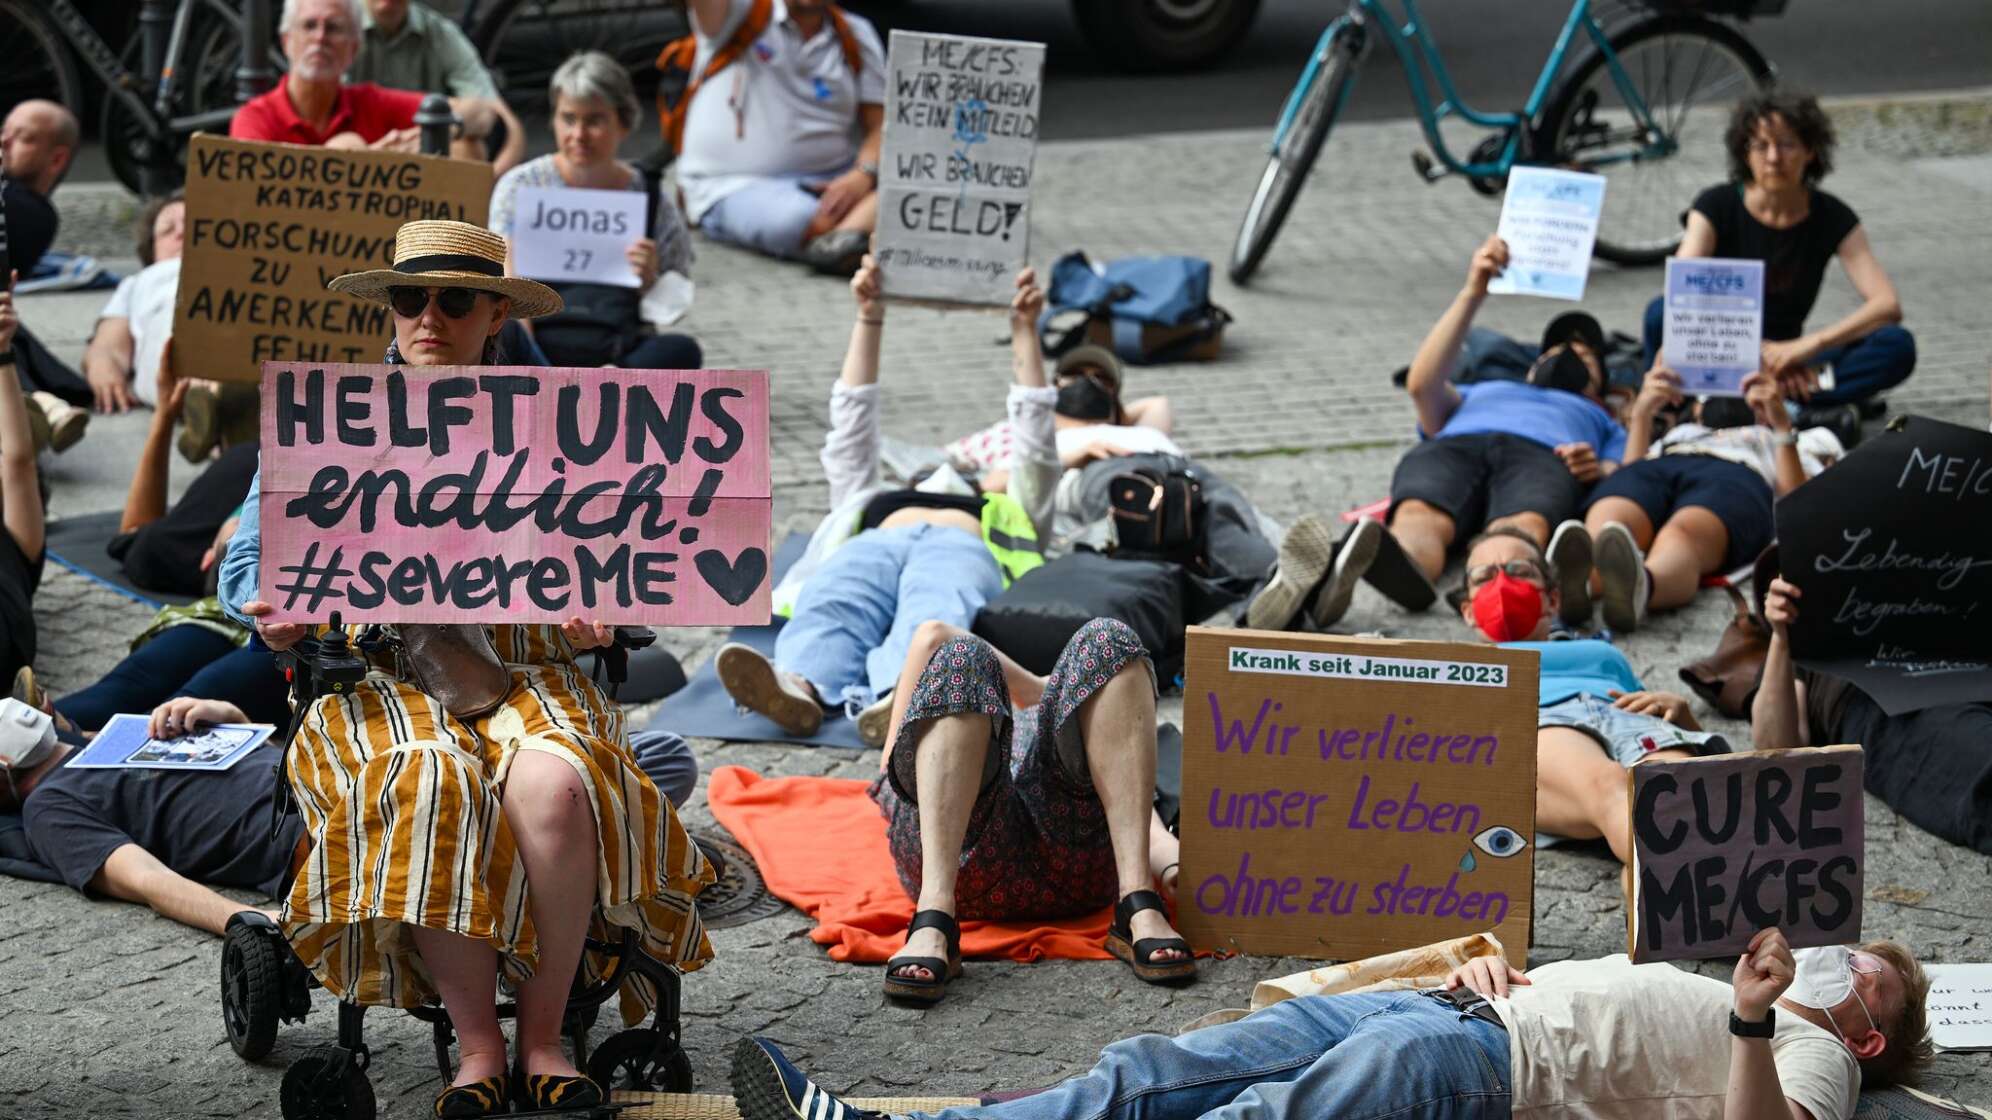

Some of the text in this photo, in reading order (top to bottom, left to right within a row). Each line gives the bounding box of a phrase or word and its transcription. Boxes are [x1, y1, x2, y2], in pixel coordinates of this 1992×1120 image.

[897, 69, 1036, 107] WIR BRAUCHEN
[897, 101, 951, 128] KEIN
[198, 149, 421, 190] VERSORGUNG
[897, 153, 1032, 189] WIR BRAUCHEN
[530, 199, 628, 235] Jonas
[900, 192, 1024, 242] GELD!
[250, 257, 291, 286] ZU
[563, 248, 593, 271] 27
[187, 286, 394, 337] ANERKENN
[1672, 312, 1692, 322] Wir
[277, 369, 746, 466] HELFT UNS
[285, 446, 723, 544] endlich!
[275, 541, 679, 614] #severeME
[1815, 527, 1992, 591] Lebendig
[1231, 650, 1505, 684] Krank seit Januar 2023
[1207, 691, 1498, 766] Wir verlieren
[1207, 774, 1481, 835] unser Leben
[1633, 764, 1843, 856] CURE
[1194, 851, 1510, 926] ohne zu sterben
[1641, 850, 1858, 951] ME/CFS
